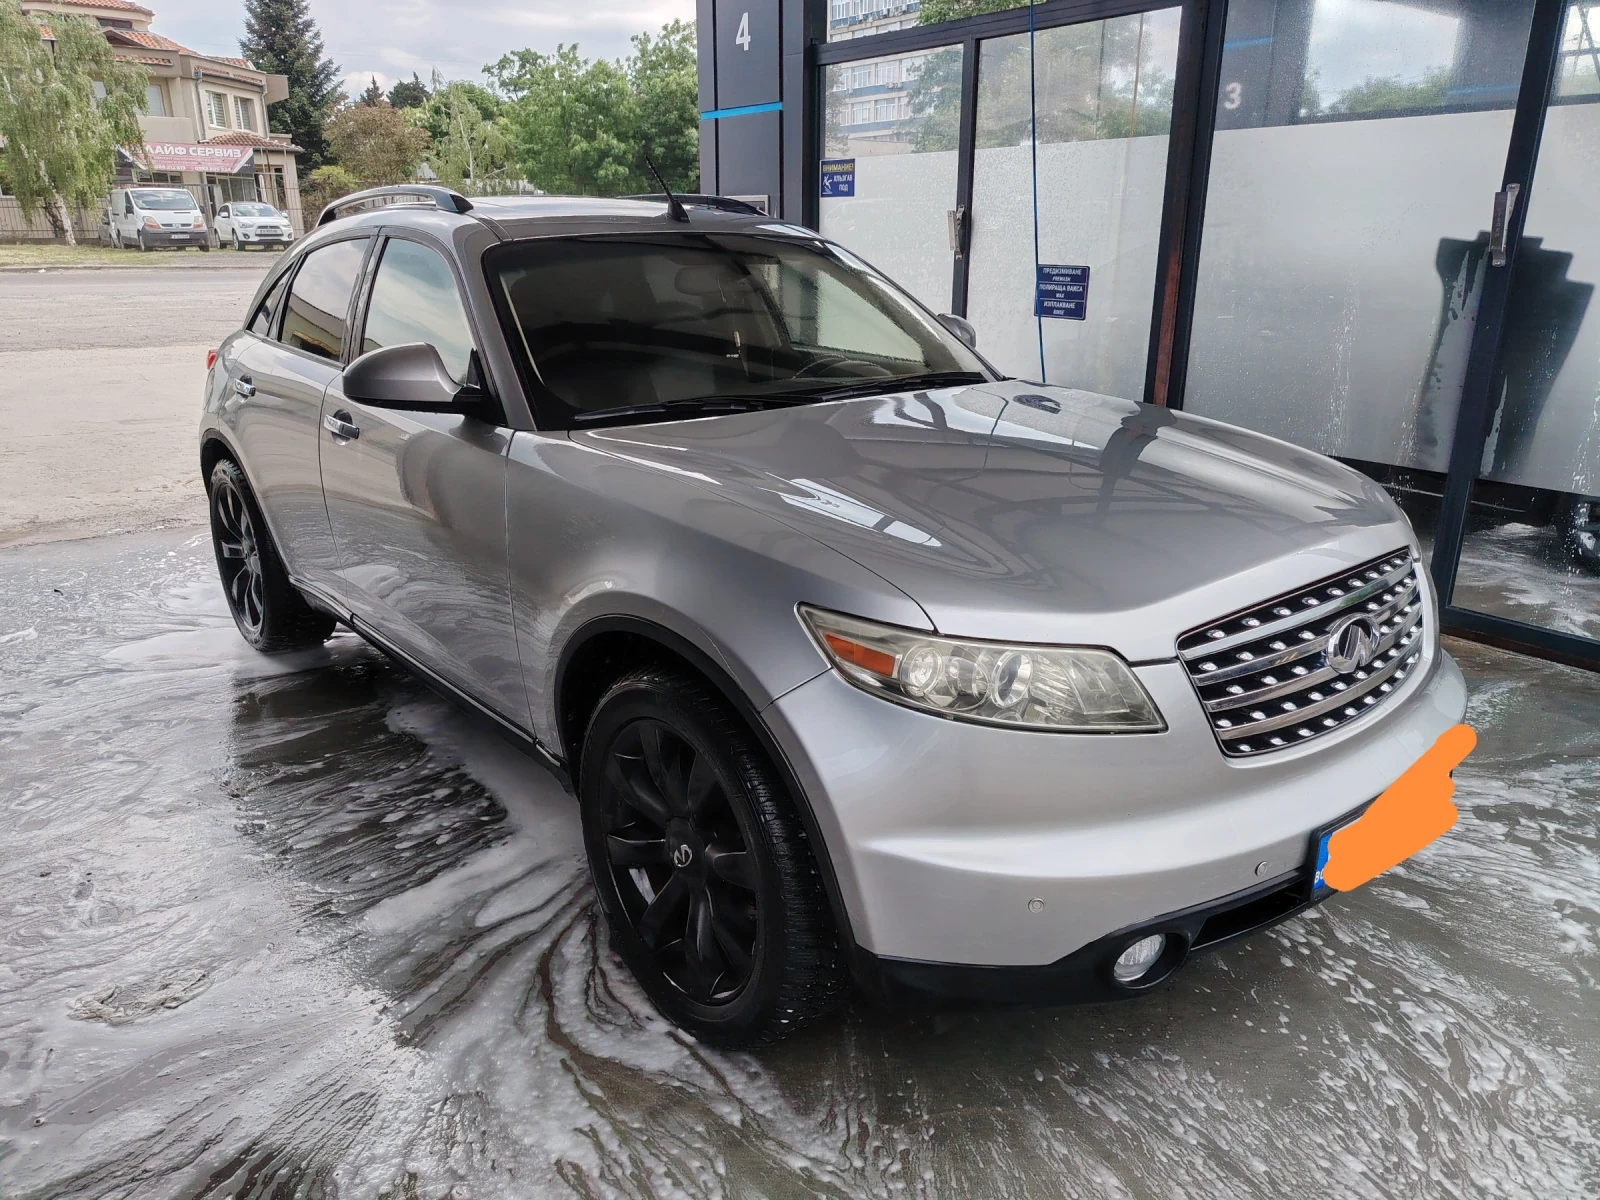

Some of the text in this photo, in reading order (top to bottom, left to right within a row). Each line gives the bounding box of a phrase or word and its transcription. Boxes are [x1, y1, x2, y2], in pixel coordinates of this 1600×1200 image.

[735, 12, 752, 52] 4
[1224, 82, 1241, 109] 3
[189, 147, 242, 158] СЕРВИЗ
[1043, 267, 1082, 275] ПРЕДИЗМИВАНЕ
[1043, 301, 1076, 309] ИЗПЛАКВАНЕ
